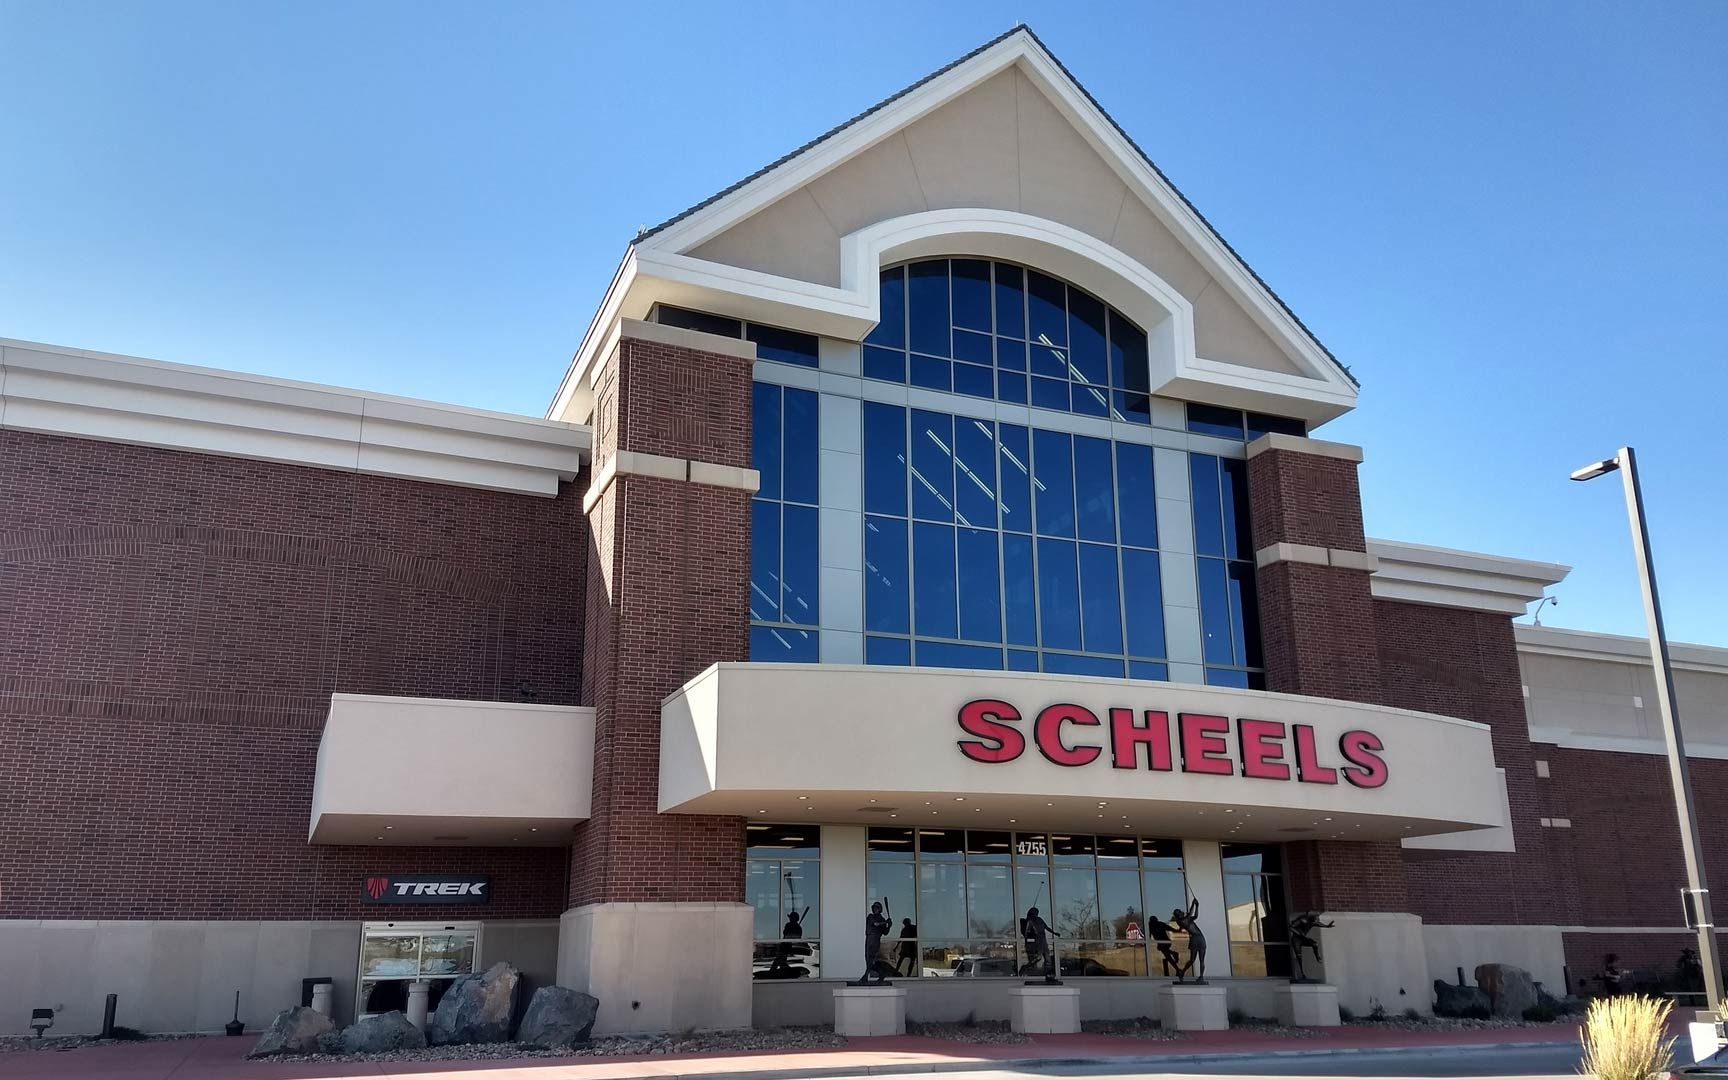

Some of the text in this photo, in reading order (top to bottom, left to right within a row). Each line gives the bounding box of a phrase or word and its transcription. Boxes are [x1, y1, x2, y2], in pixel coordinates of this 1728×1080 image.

[957, 698, 1388, 788] SCHEELS
[1018, 841, 1046, 856] 4755
[394, 882, 487, 895] TREK
